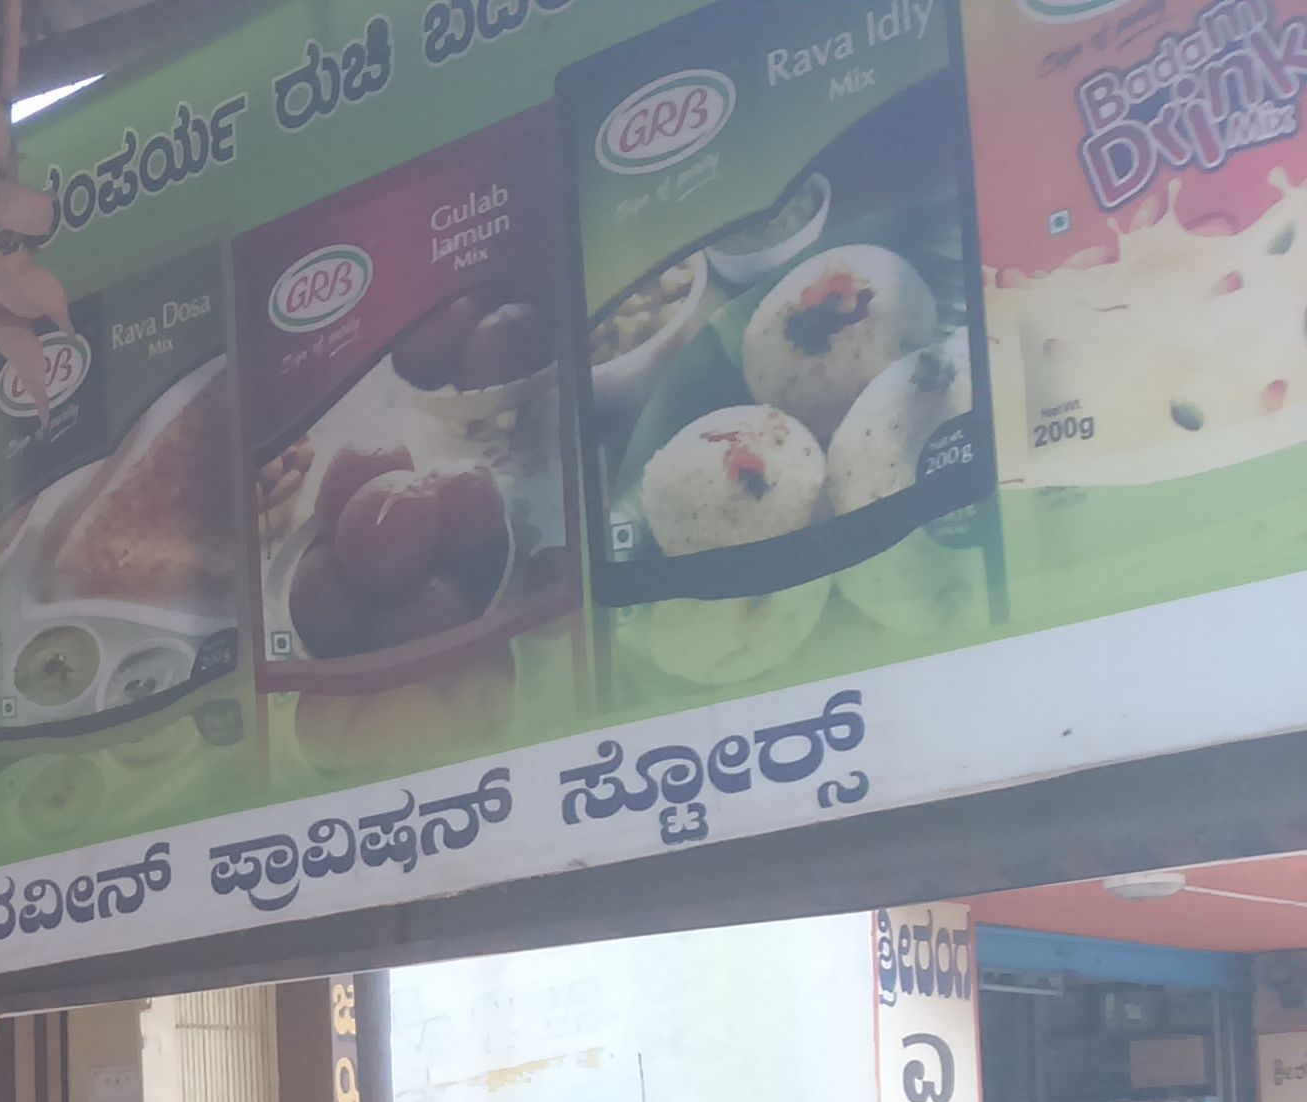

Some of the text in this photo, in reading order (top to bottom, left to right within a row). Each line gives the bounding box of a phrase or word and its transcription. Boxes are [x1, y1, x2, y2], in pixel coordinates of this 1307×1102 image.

[767, 0, 936, 86] Rava Idly
[1079, 0, 1267, 134] Badam
[828, 66, 877, 100] Mix
[618, 87, 709, 154] GRB
[430, 183, 509, 231] Gulab
[430, 214, 510, 264] Jamun
[453, 247, 489, 271] Mix
[286, 260, 354, 314] GRB
[111, 293, 212, 351] Rava Dosa
[147, 337, 175, 360] Mix
[1033, 416, 1095, 448] 200g
[208, 766, 513, 911] ಪ್ರಾವಿಷನ್
[559, 688, 871, 846] ಸ್ಟೋರ್ಸ್
